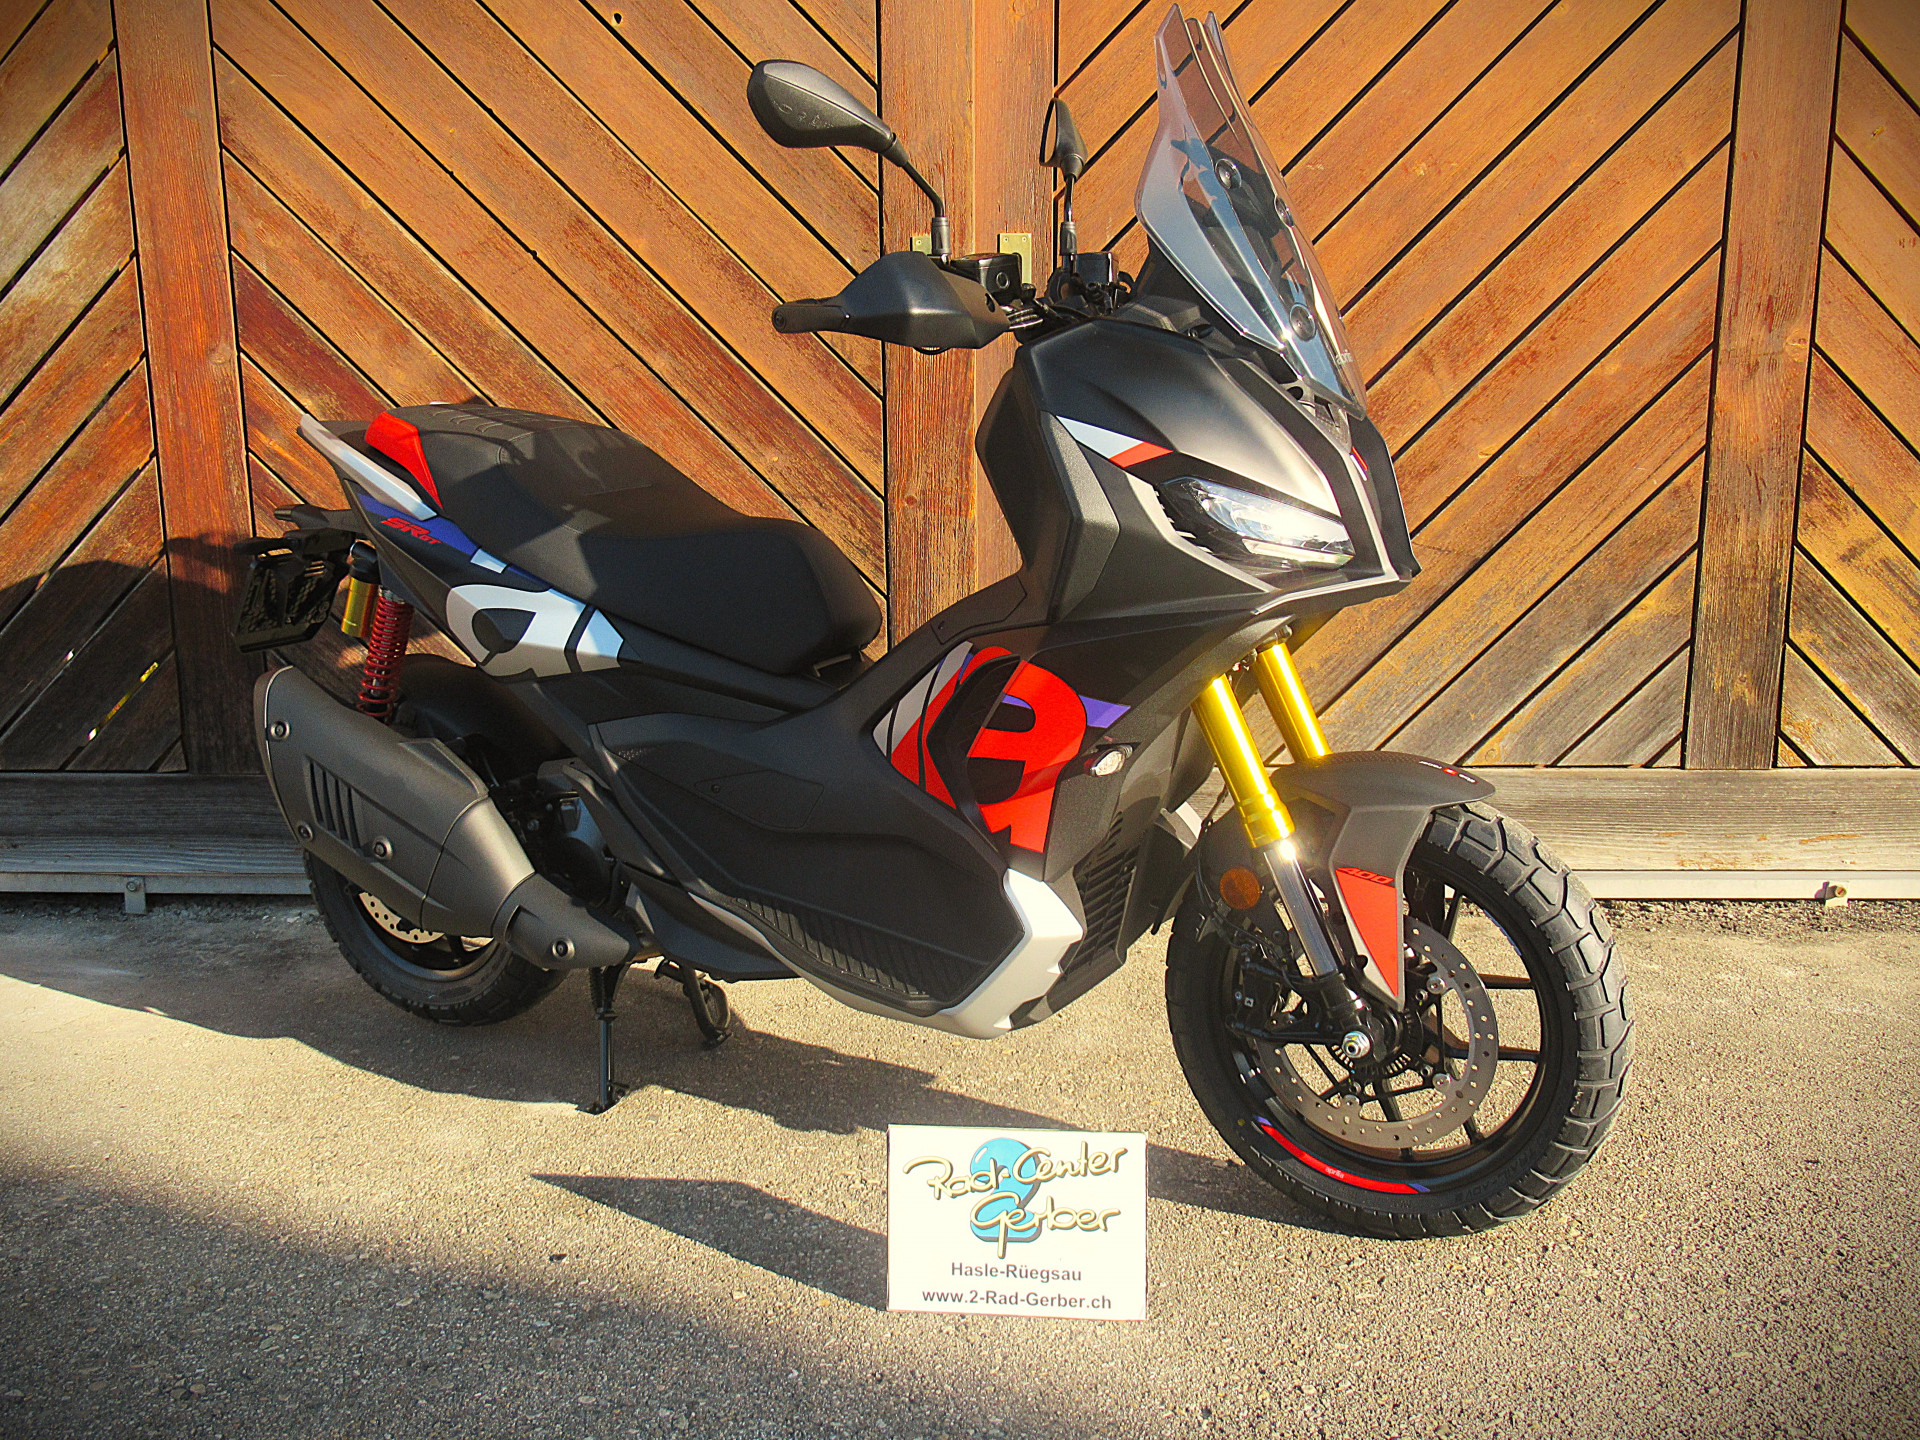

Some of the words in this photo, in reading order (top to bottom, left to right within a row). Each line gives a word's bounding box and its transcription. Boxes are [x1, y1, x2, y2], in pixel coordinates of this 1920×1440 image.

[380, 517, 430, 538] SR
[1337, 866, 1395, 886] 400
[969, 1191, 1121, 1259] Gerber
[951, 1262, 1082, 1284] Hasle-Rüegsau
[922, 1289, 1112, 1310] www.2-Rad-Gerber.ch
